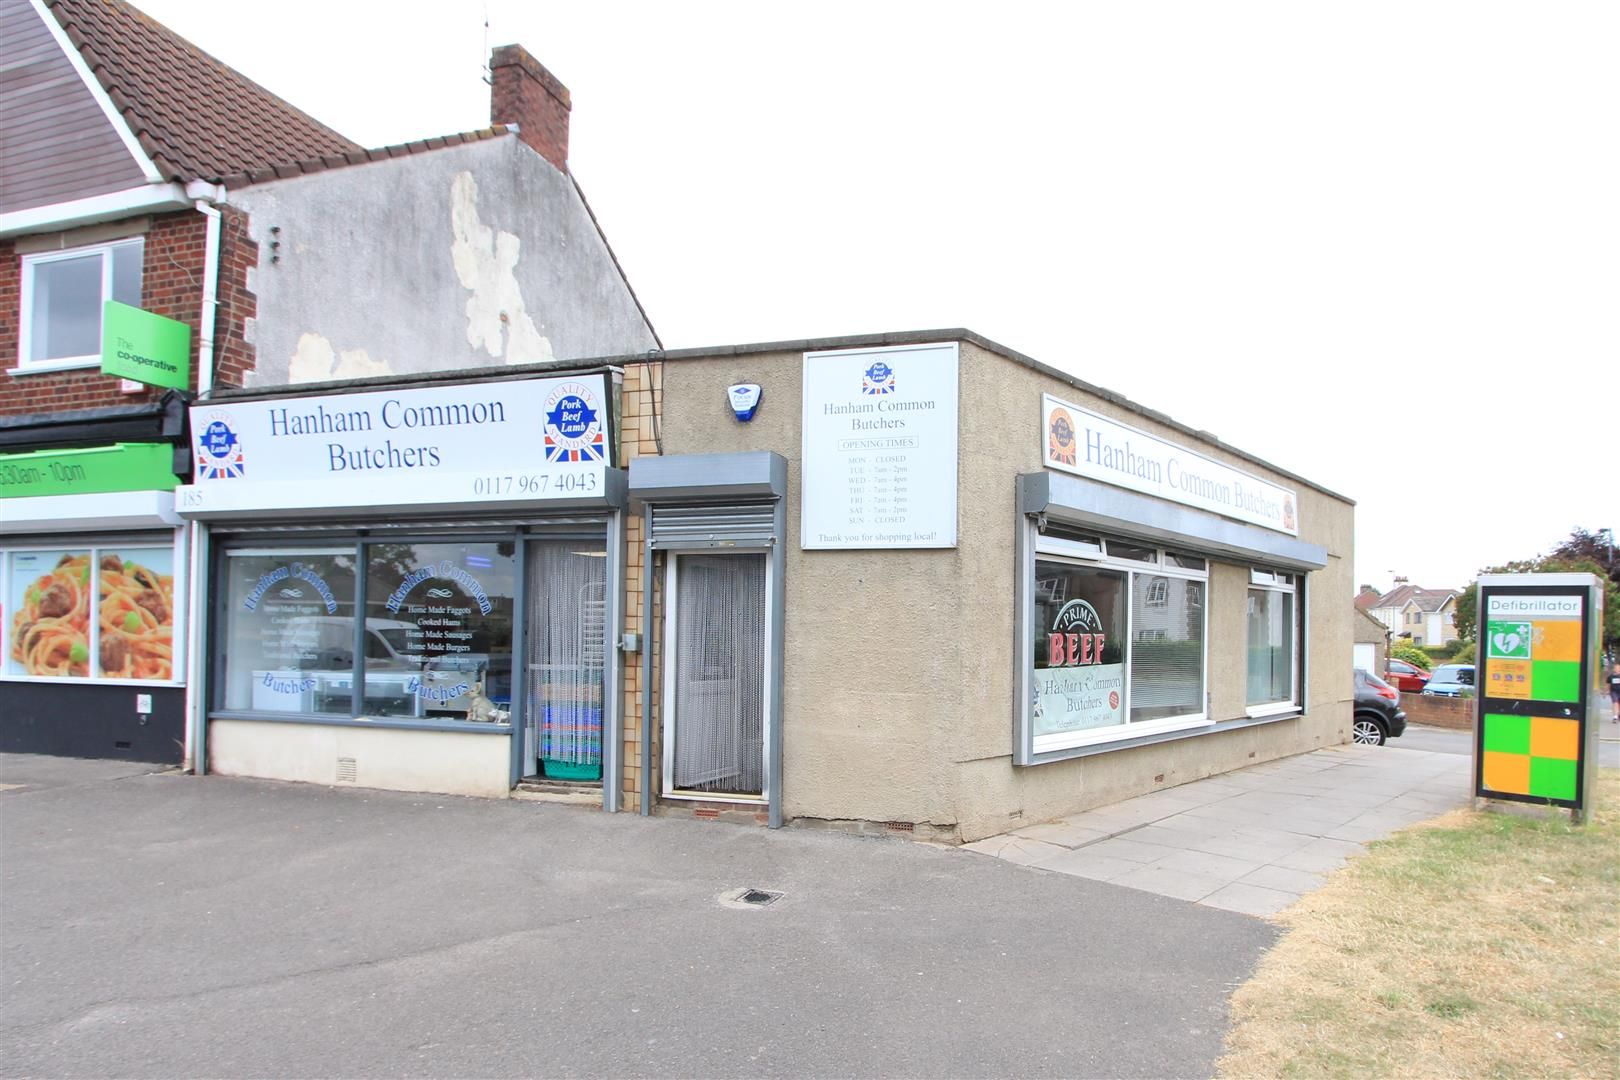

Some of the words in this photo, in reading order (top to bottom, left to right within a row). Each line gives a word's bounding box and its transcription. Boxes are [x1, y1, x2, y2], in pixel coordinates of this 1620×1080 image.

[118, 337, 134, 350] The
[117, 351, 178, 373] co-operative
[548, 384, 594, 406] QUALITY
[561, 399, 582, 410] Pork
[824, 402, 874, 416] Hanham
[878, 400, 936, 412] Common
[270, 405, 372, 436] Hanham
[382, 400, 505, 429] Common
[562, 411, 582, 422] Beef
[852, 418, 905, 430] Butchers
[561, 422, 586, 432] Lamb
[550, 428, 596, 448] STANDARD
[842, 440, 883, 448] OPENING
[886, 439, 914, 447] TIMES
[328, 440, 440, 472] Butchers
[48, 462, 87, 485] 10pm
[1085, 427, 1162, 484] Hanham
[1167, 458, 1230, 505] Common
[1234, 481, 1280, 521] Butchers
[474, 476, 512, 494] 0117
[519, 475, 548, 493] 967
[554, 472, 596, 492] 4043
[183, 490, 202, 506] 185
[818, 534, 841, 542] Thank
[844, 535, 858, 544] you
[875, 533, 912, 543] shopping
[914, 532, 937, 541] local!
[244, 566, 290, 613] Hanham
[386, 564, 437, 614] Hanham
[440, 560, 492, 616] Common
[447, 606, 471, 616] Faggots
[1491, 600, 1578, 610] Defibrillator
[1064, 607, 1093, 626] PRIME
[444, 631, 472, 640] Sausages
[446, 643, 470, 652] Burgers
[1048, 632, 1105, 666] BEEF
[262, 672, 316, 694] Butchers
[408, 677, 468, 700] Butchers
[1067, 696, 1102, 712] Butchers
